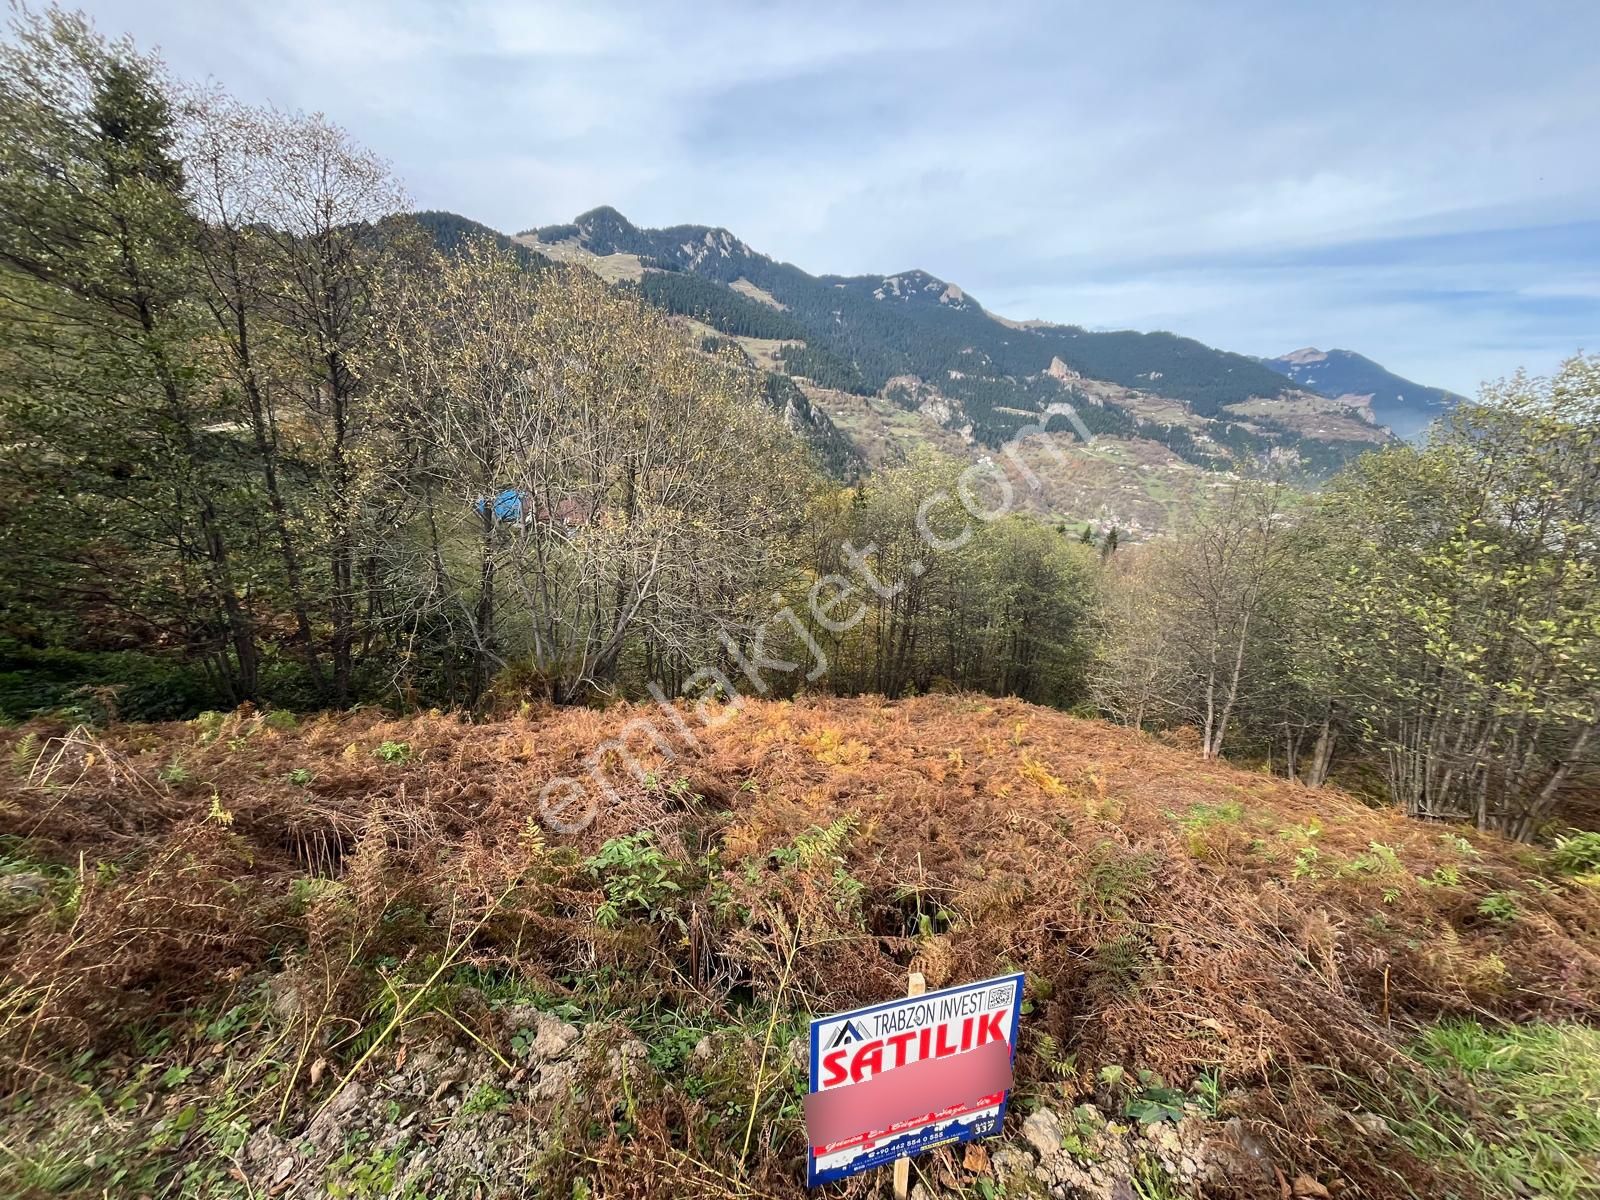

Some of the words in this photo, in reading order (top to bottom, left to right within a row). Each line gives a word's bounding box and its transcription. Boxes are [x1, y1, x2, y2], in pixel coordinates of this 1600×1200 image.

[874, 1004, 936, 1036] TRABZON
[939, 990, 987, 1020] INVEST
[823, 1009, 1008, 1087] SATILIK
[975, 1123, 994, 1134] 337
